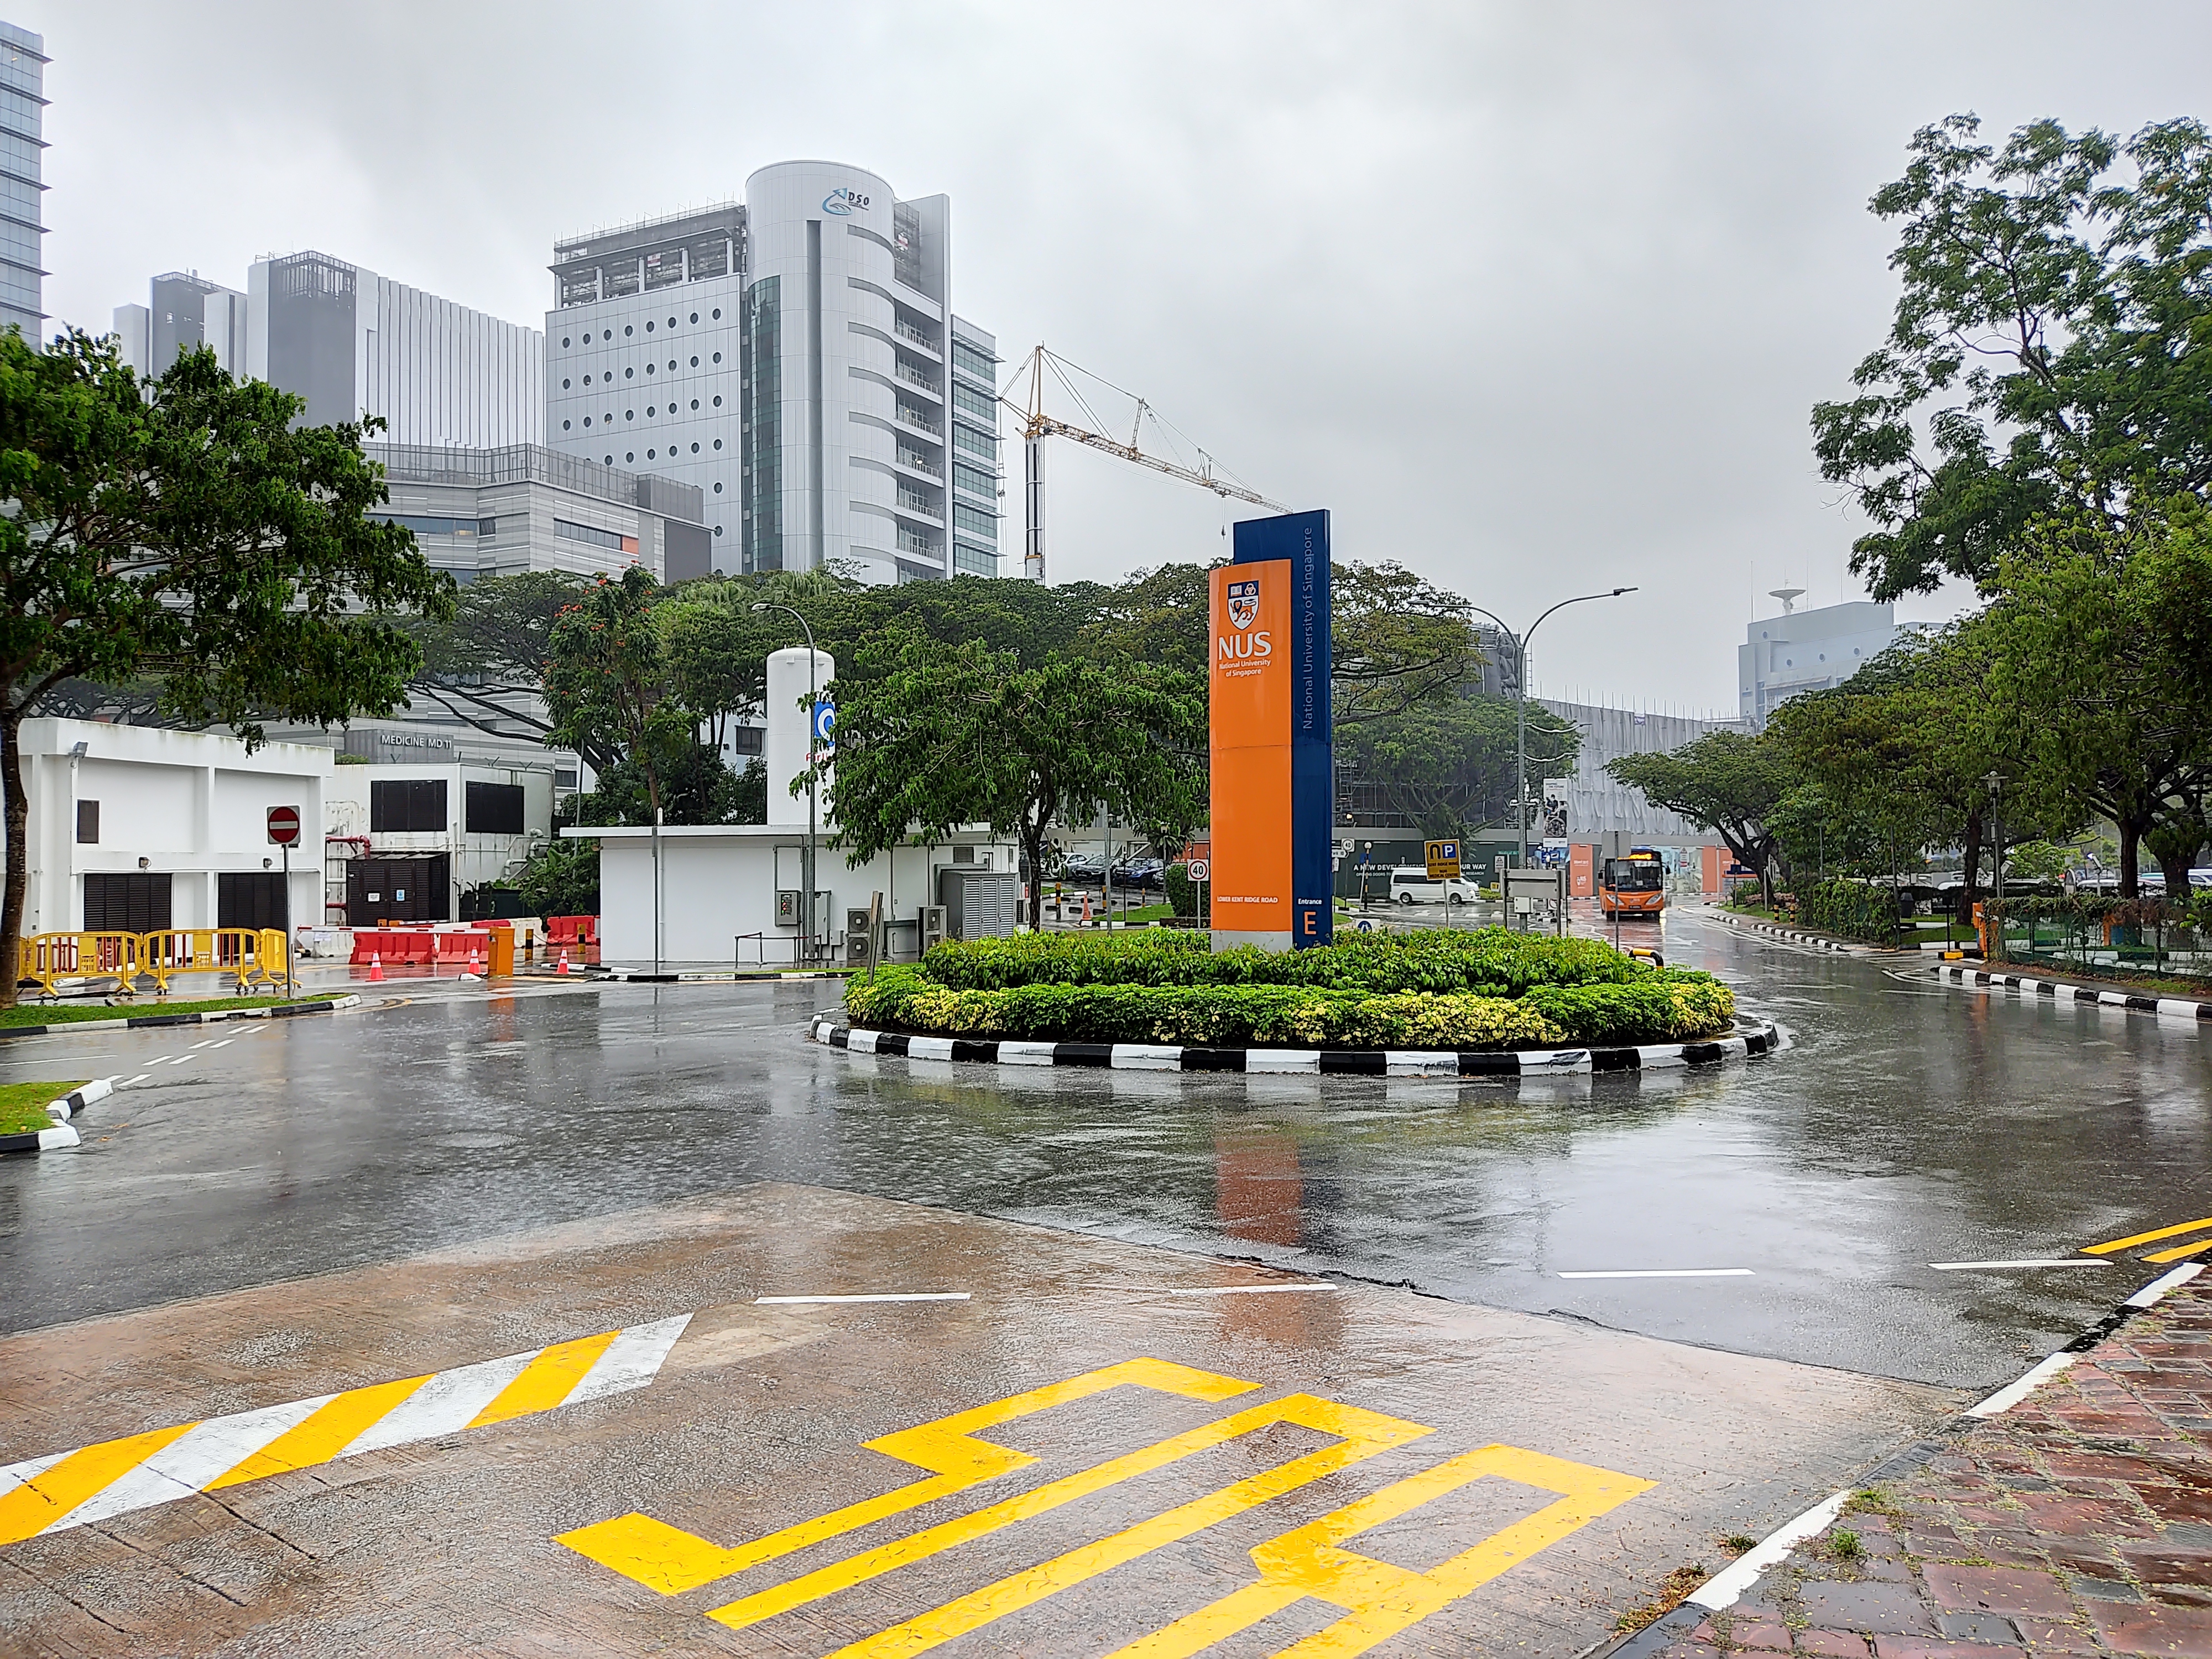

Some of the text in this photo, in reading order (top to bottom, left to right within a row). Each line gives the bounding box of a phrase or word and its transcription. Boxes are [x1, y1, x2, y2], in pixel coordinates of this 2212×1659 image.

[848, 191, 869, 206] DSO
[1302, 527, 1314, 729] National University of Singapore
[1219, 631, 1272, 660] NUS
[1219, 659, 1271, 670] National University
[1232, 668, 1262, 677] Singapore
[381, 734, 452, 749] MEDICINE MD 11
[1444, 845, 1453, 857] P
[1193, 865, 1203, 875] 40
[1305, 911, 1317, 935] E
